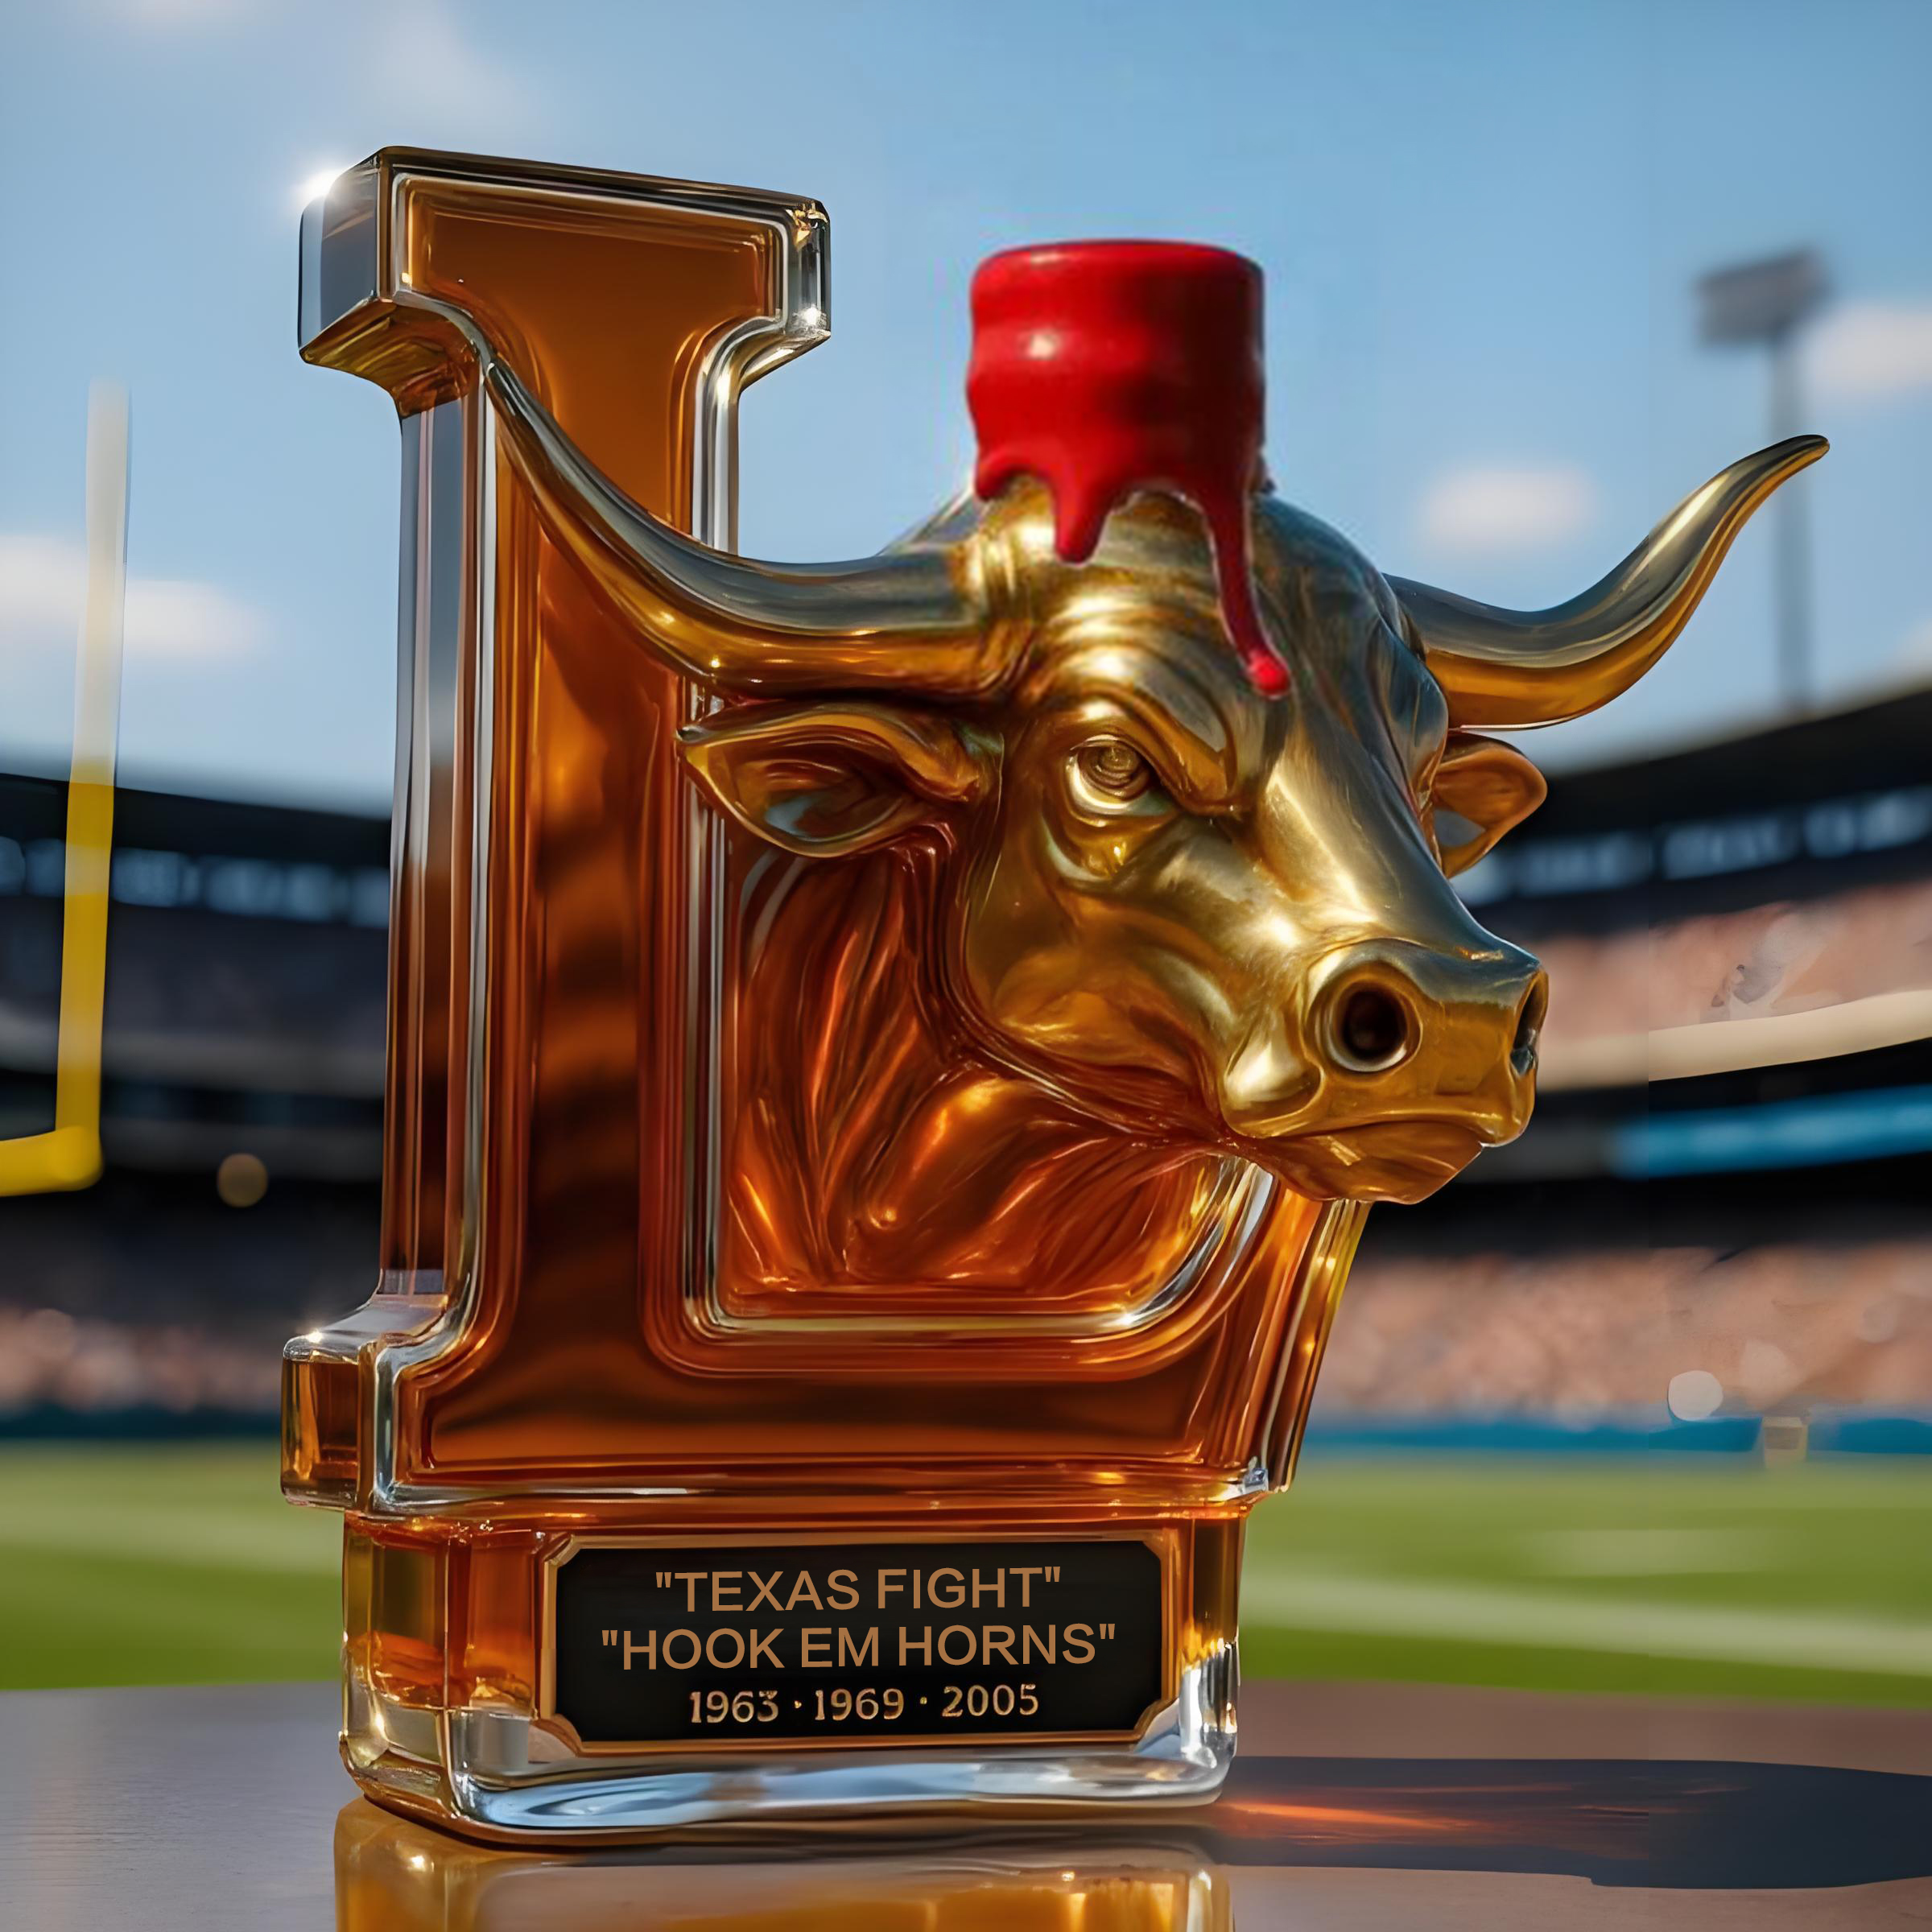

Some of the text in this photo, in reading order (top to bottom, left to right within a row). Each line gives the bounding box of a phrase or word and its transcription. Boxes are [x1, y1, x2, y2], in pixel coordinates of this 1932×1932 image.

[656, 1567, 1060, 1612] "TEXAS FIGHT"
[602, 1624, 1115, 1670] "HOOK EM HORNS"
[690, 1684, 1038, 1723] 1963 1969 2005
